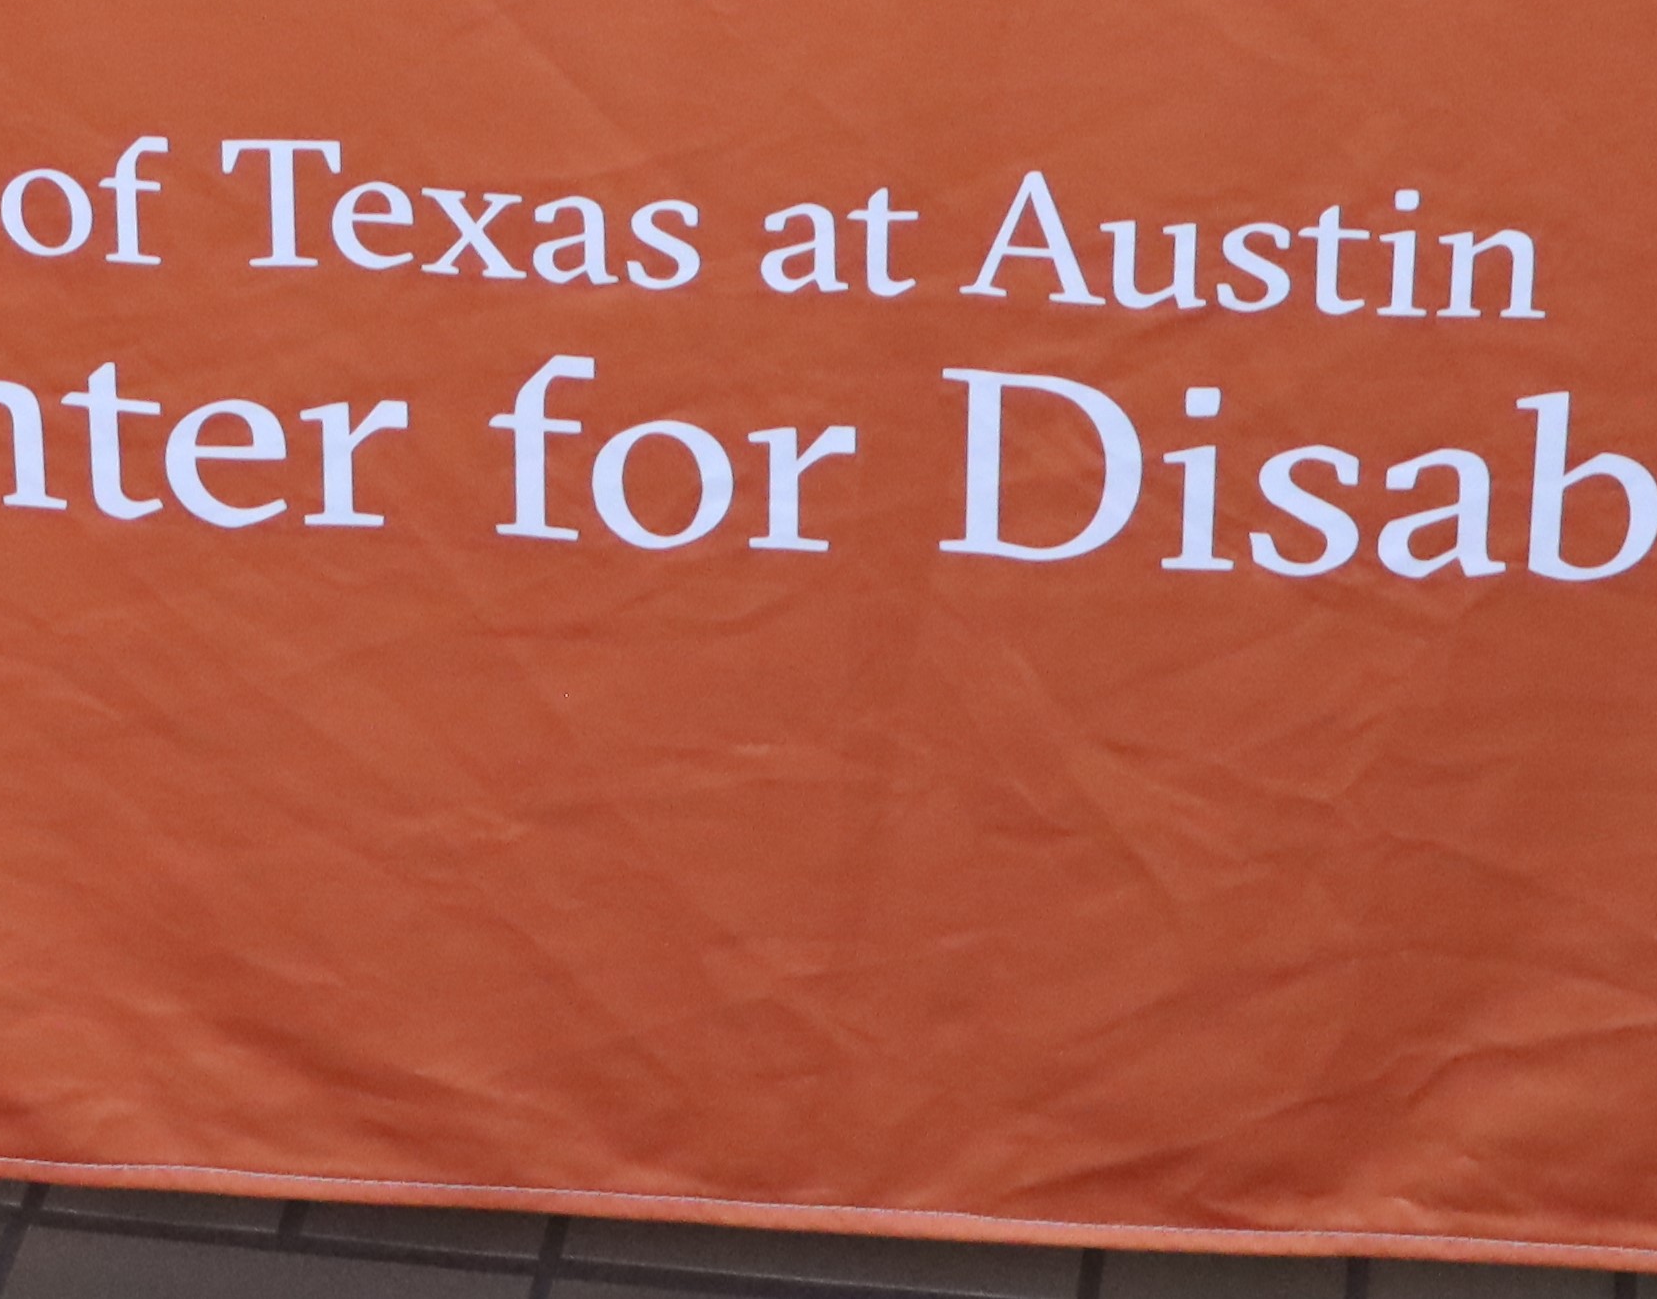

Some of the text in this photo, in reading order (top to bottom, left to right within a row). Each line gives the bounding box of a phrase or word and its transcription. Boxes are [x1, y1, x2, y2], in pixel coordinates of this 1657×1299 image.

[0, 135, 169, 266] of
[221, 138, 701, 290] Texas
[760, 186, 919, 296] at
[960, 170, 1547, 321] Austin
[490, 355, 857, 552] for
